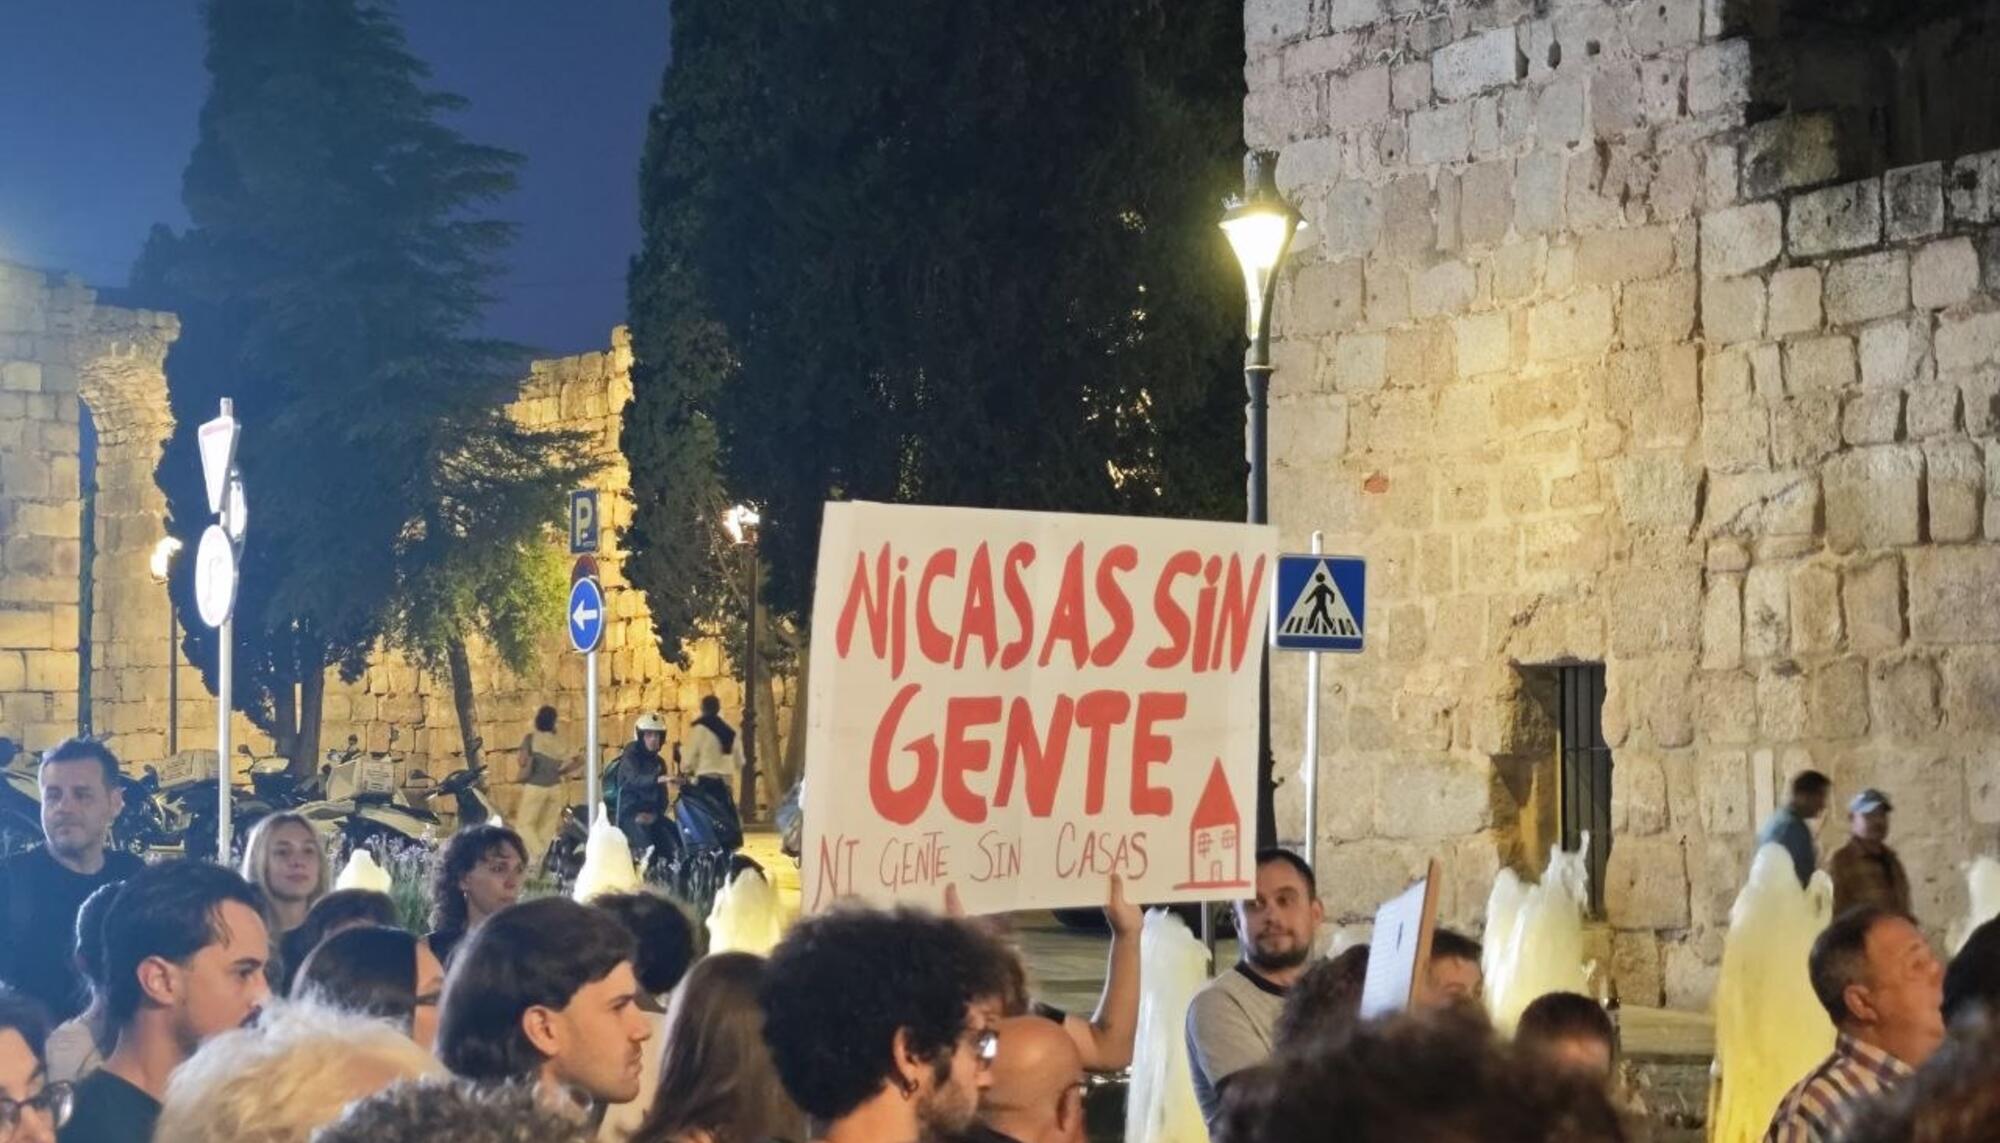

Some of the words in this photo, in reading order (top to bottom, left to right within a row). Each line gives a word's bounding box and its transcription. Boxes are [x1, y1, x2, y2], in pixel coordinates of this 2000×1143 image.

[576, 497, 593, 546] P
[916, 540, 1138, 671] CASAS
[868, 683, 1187, 825] GENTE
[811, 834, 860, 912] NI
[879, 830, 950, 893] GENTE
[969, 829, 1022, 882] SIN
[1056, 821, 1149, 880] CASAS
